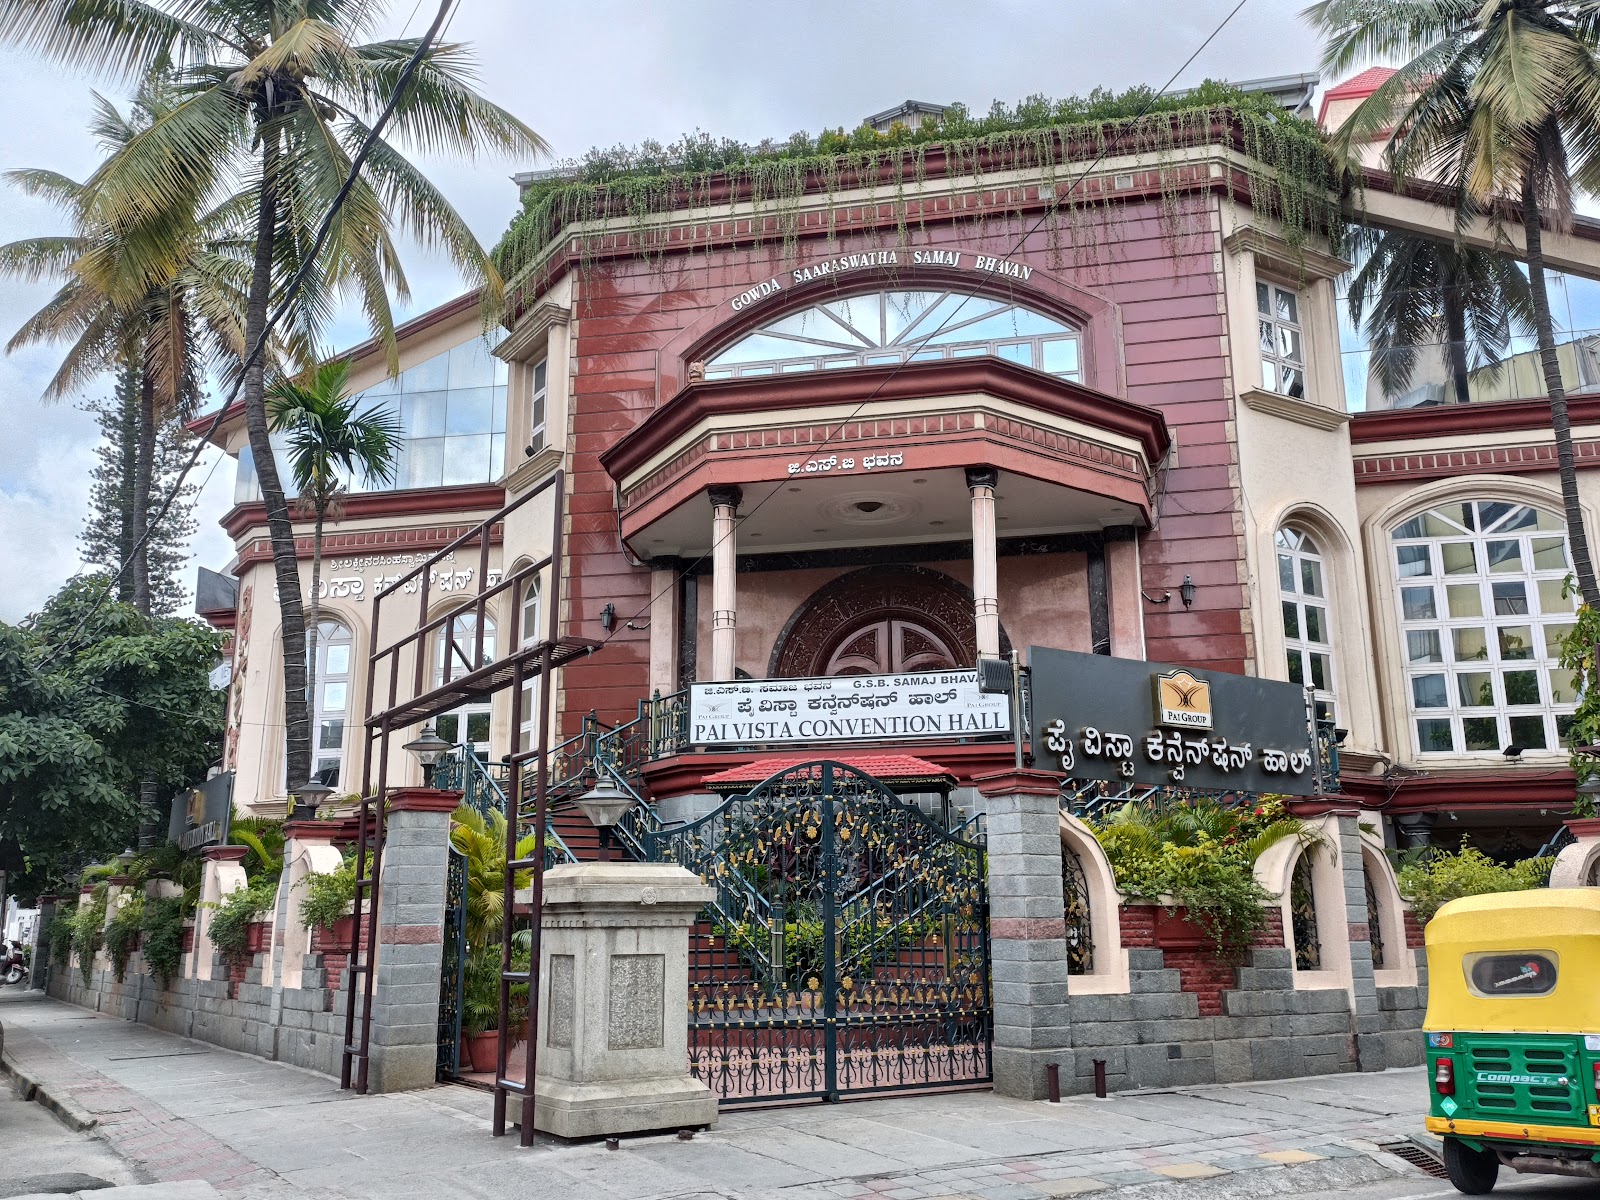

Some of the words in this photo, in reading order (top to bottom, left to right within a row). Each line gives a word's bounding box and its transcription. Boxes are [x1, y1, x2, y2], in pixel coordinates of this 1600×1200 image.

[731, 278, 782, 311] GOWDA
[792, 250, 898, 284] SAARASWATHA
[913, 250, 962, 268] SAMAJ
[974, 255, 1034, 281] BHAVAN
[862, 451, 904, 470] ಭವನ
[759, 682, 798, 694] ಸಮಾಜ
[803, 681, 832, 692] ಭವನ
[853, 679, 890, 689] G.S.B.
[894, 676, 937, 687] SAMAJ
[737, 697, 755, 718] ಪೈ
[908, 688, 958, 706] ಹಾಲ್
[694, 723, 728, 742] PAI
[732, 720, 794, 740] VISTA
[798, 714, 943, 738] CONVENTION
[948, 711, 1006, 731] HALL
[1046, 718, 1075, 771] ಪೈ
[1083, 726, 1135, 778] ವಿಸ್ಟಾ
[1262, 748, 1312, 775] ಹಾಲ್
